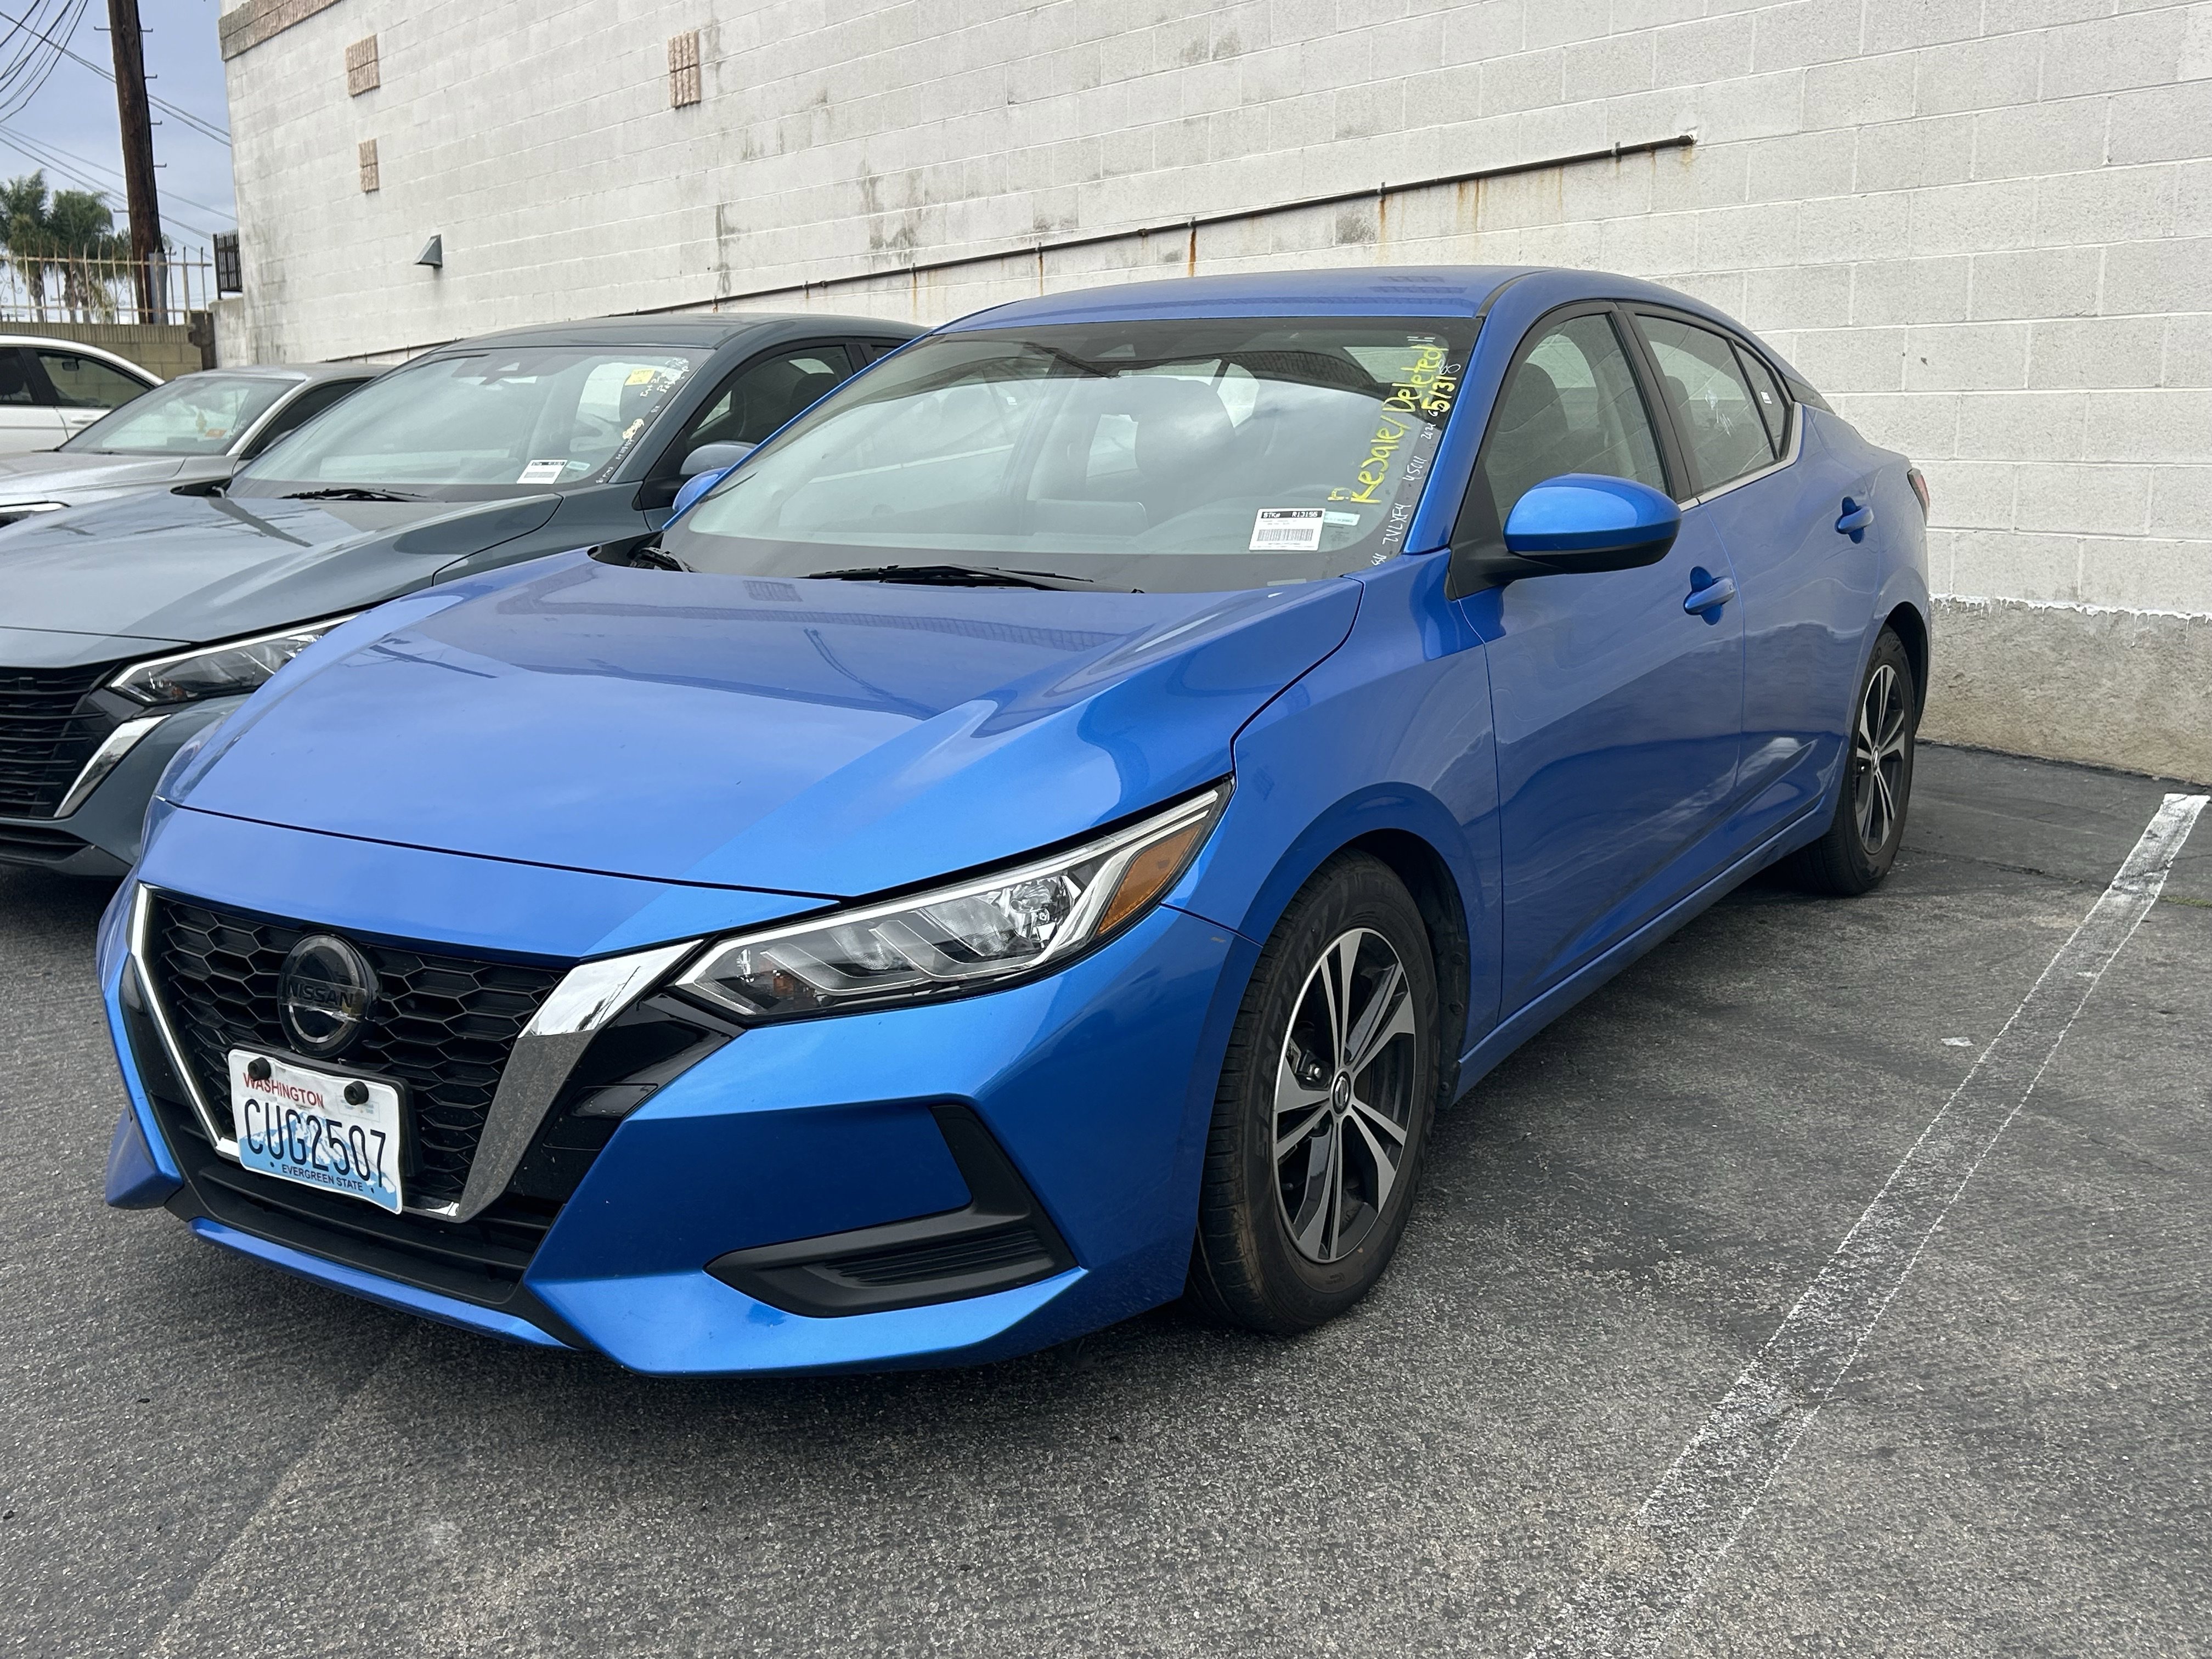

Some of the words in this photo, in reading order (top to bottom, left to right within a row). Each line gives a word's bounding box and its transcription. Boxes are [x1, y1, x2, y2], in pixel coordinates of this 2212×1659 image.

[287, 982, 354, 1008] NISSAN
[243, 1073, 324, 1109] WASHINGTON
[244, 1098, 386, 1188] CUG2507
[281, 1164, 334, 1184] EVERGREEN
[336, 1177, 363, 1192] STATE
